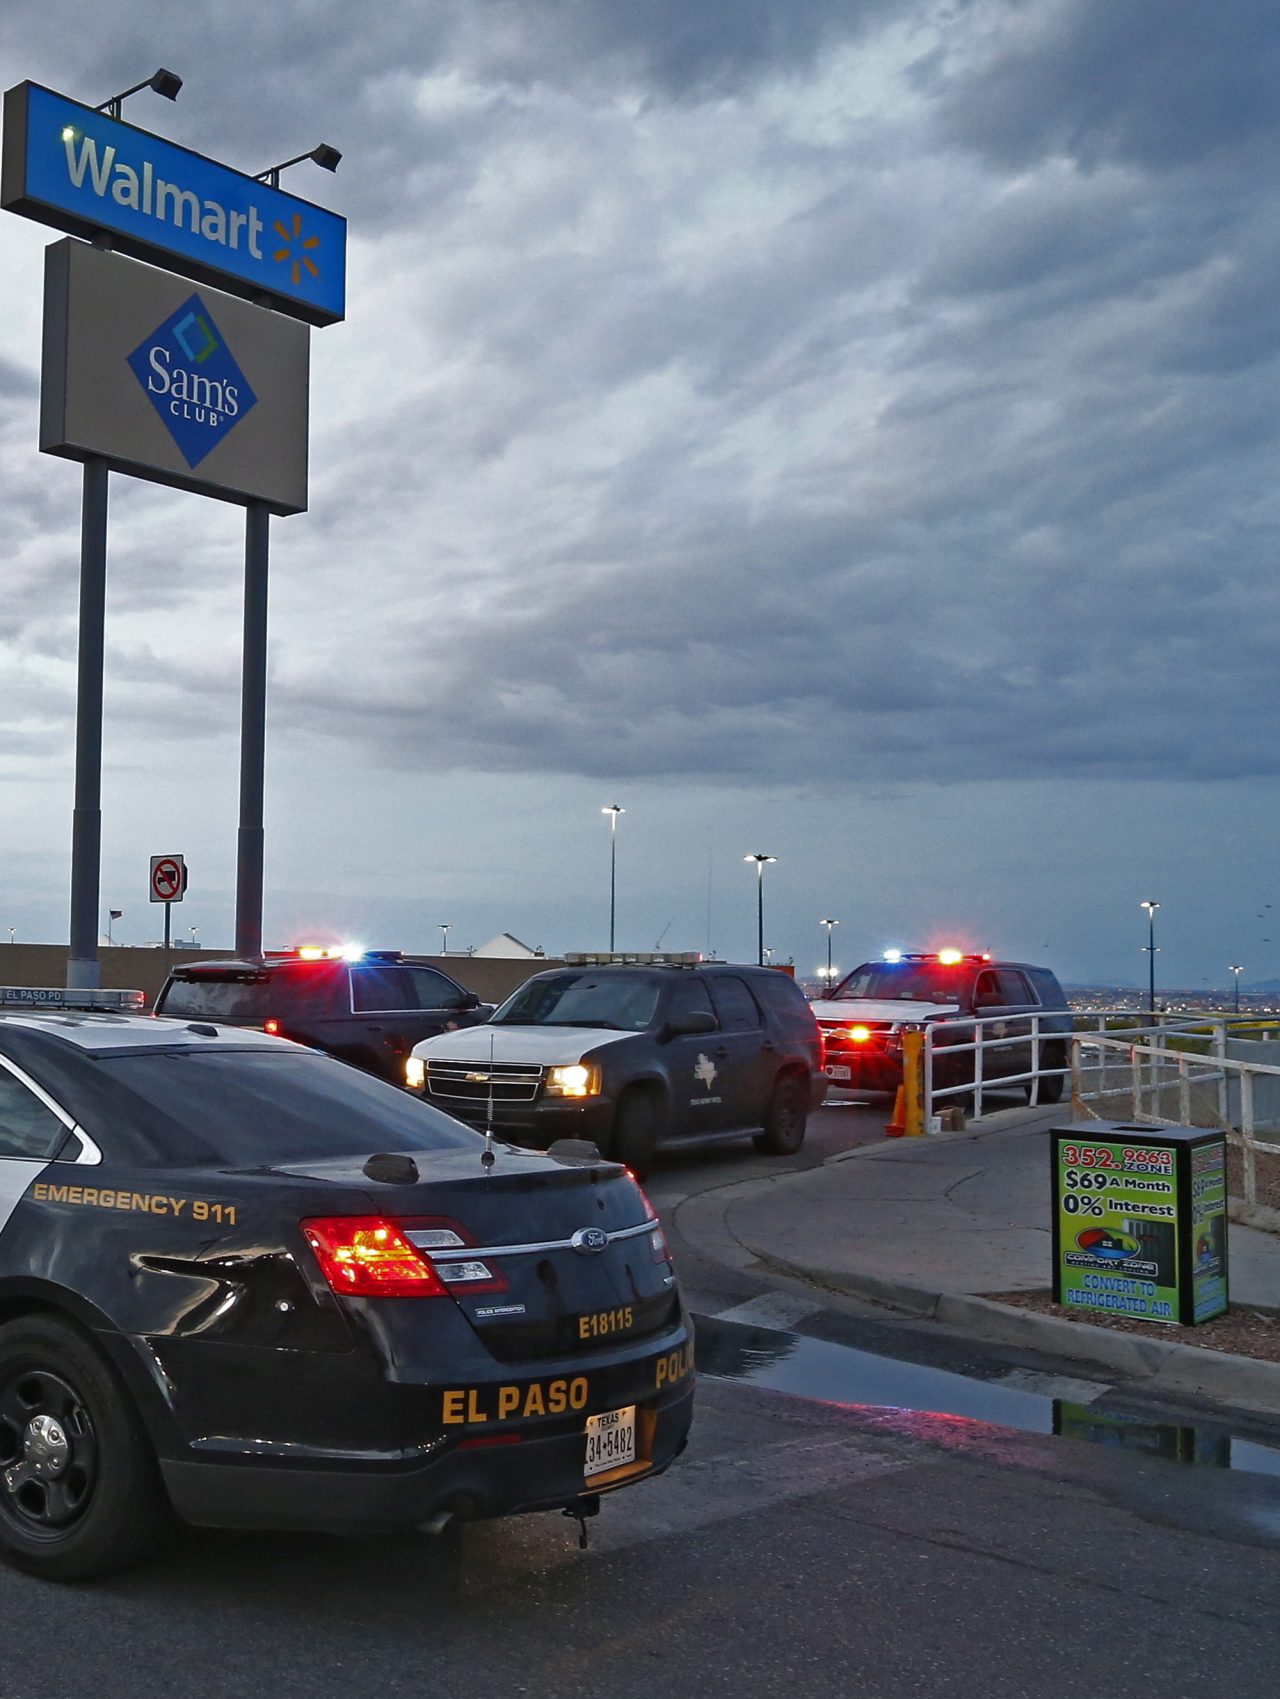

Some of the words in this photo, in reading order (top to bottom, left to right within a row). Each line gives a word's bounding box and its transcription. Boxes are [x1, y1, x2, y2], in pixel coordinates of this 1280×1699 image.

[62, 129, 263, 260] Walmart
[148, 346, 238, 416] Sam's
[170, 401, 218, 427] CLUB
[6, 990, 19, 1000] EL
[20, 990, 46, 1001] PASO
[48, 991, 61, 1001] PD
[1063, 1145, 1122, 1169] 352.
[1122, 1148, 1173, 1166] 9663
[1124, 1162, 1173, 1175] ZONE
[1065, 1169, 1108, 1190] $69
[1109, 1178, 1120, 1187] A
[1124, 1179, 1172, 1192] Month
[33, 1183, 186, 1216] EMERGENCY
[192, 1201, 236, 1225] 911
[1063, 1194, 1104, 1217] 0%
[1108, 1199, 1175, 1217] Interest
[1083, 1274, 1137, 1295] CONVERT
[1139, 1281, 1157, 1297] TO
[1066, 1289, 1149, 1313] REFRIGERATED
[1151, 1301, 1172, 1317] AIR
[579, 1307, 633, 1339] E18115
[442, 1390, 488, 1424] EL
[498, 1377, 589, 1420] PASO
[597, 1413, 619, 1427] TEXAS
